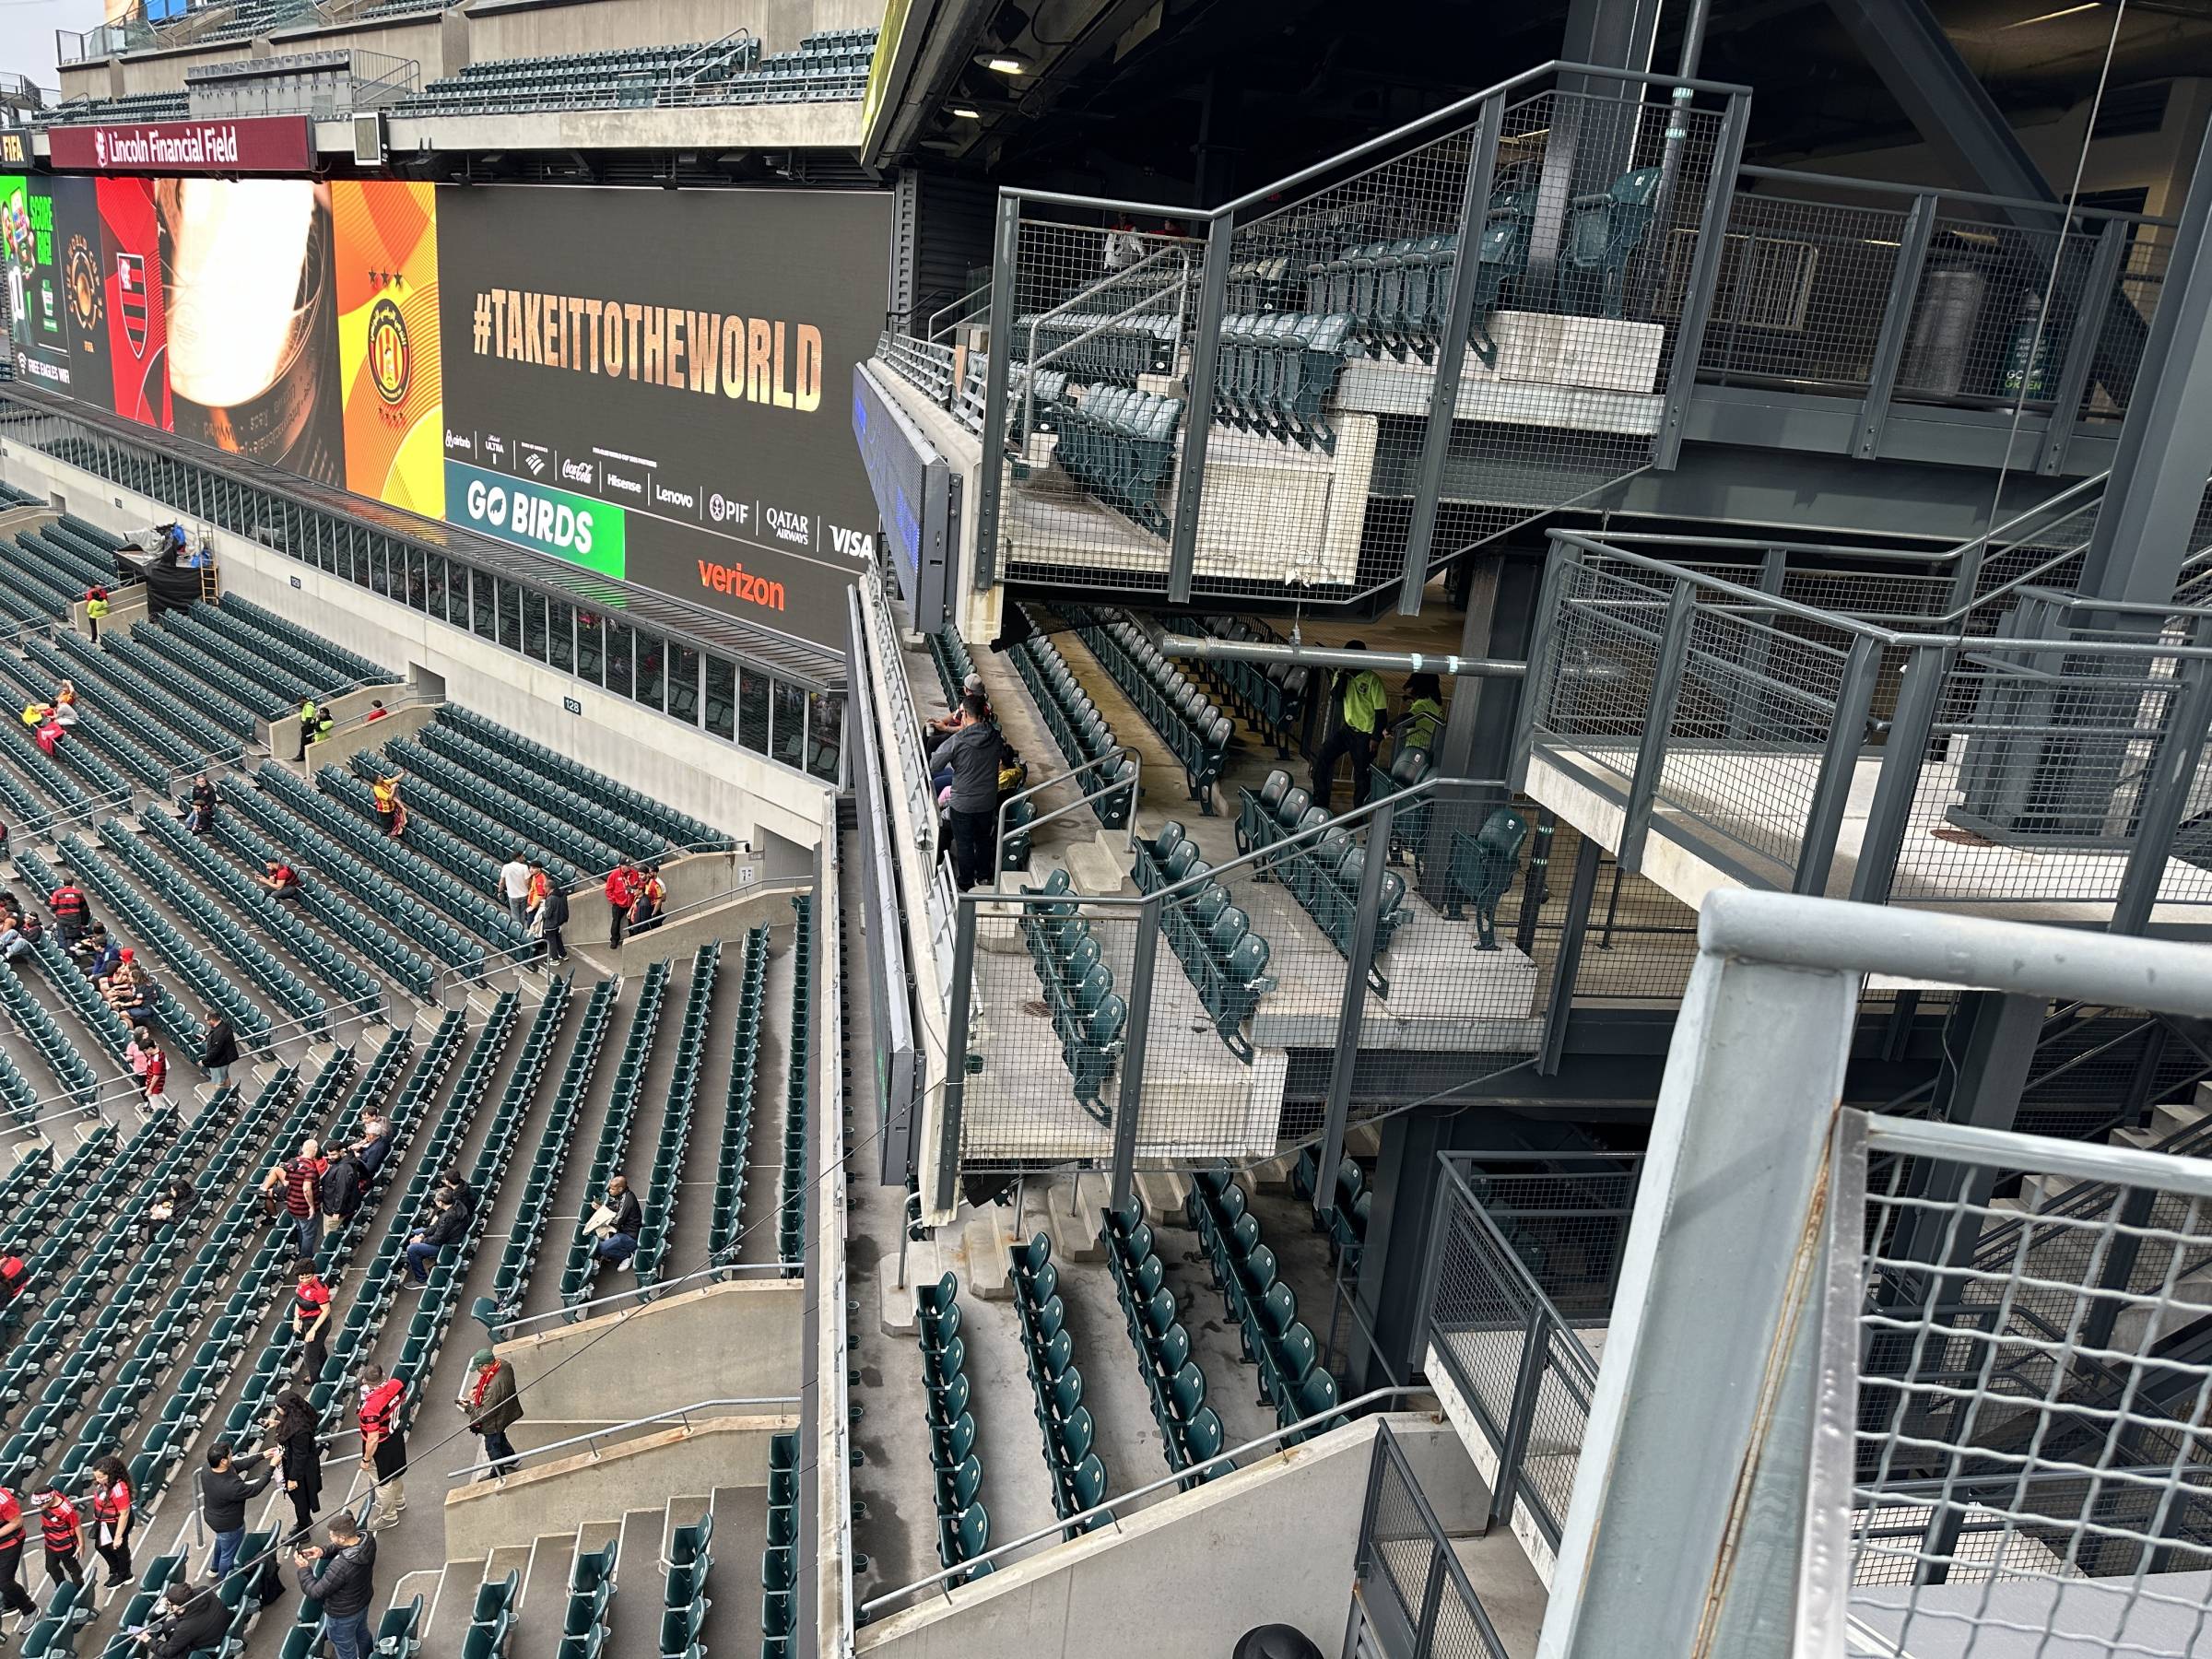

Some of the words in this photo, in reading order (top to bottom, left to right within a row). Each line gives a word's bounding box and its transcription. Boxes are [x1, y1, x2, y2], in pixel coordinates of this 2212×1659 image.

[3, 135, 24, 162] FIFA
[109, 131, 149, 163] Lincoln
[149, 127, 204, 163] Financial
[204, 125, 239, 162] Field
[29, 194, 53, 231] SCORE
[473, 288, 823, 413] #TAKEITTOTHEWORLD
[28, 359, 41, 375] FREE
[40, 361, 59, 382] EAGLES
[2006, 379, 2042, 391] GREN
[453, 435, 471, 449] airbnb
[486, 441, 504, 453] ULTRA
[607, 473, 642, 493] Hisense
[656, 485, 693, 509] Lenovo
[467, 479, 508, 526] GO
[512, 491, 594, 554] BIRDS
[726, 500, 749, 524] PIF
[766, 507, 809, 535] QATAR
[776, 527, 809, 546] AIRWAYS
[829, 525, 875, 559] VISA
[698, 559, 785, 611] verizon
[565, 699, 580, 712] 128
